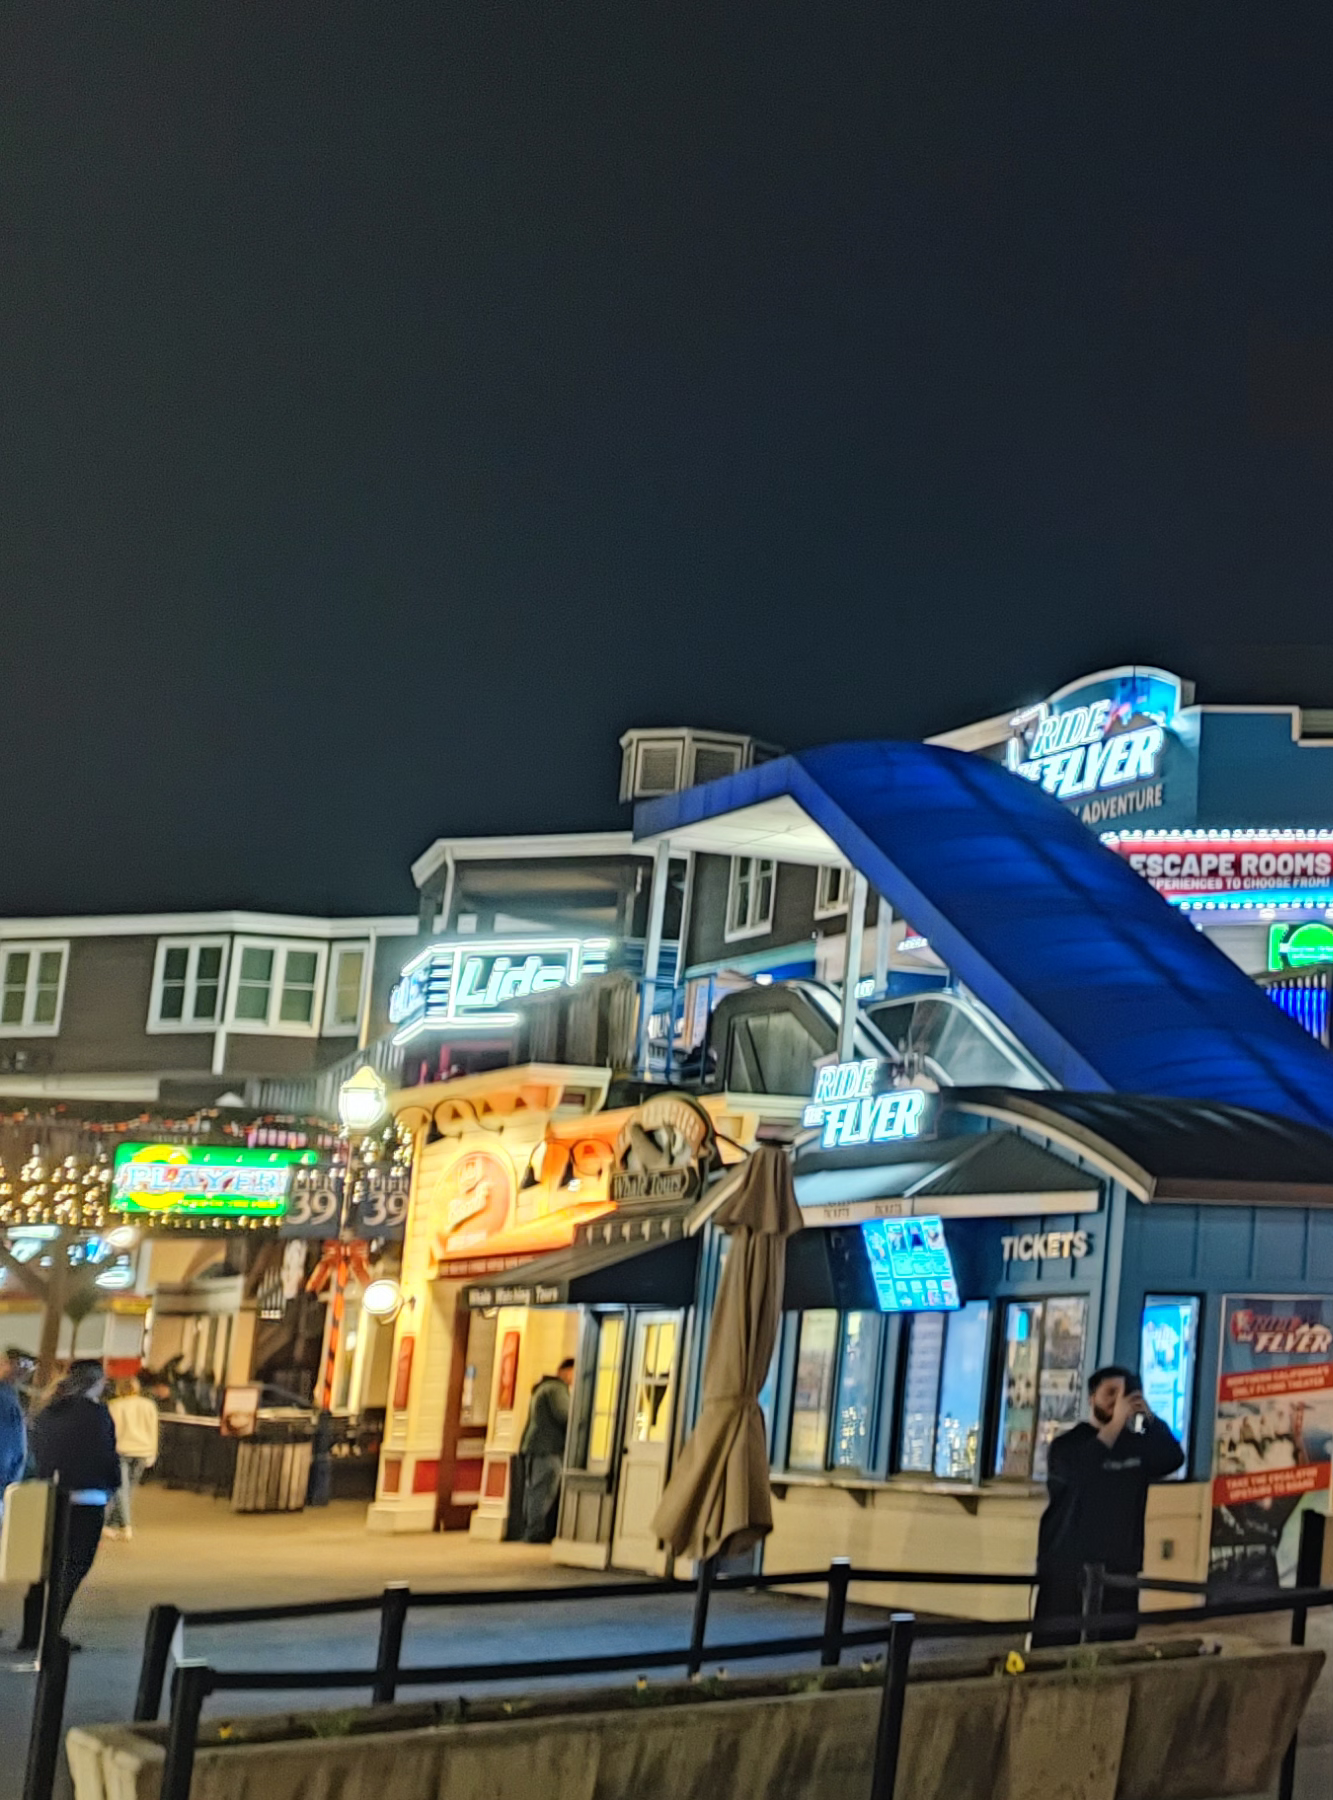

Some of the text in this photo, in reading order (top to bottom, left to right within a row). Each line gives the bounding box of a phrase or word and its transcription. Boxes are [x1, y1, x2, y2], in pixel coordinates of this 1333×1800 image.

[1030, 699, 1111, 759] RIDE
[1041, 726, 1164, 799] FLYER
[1082, 783, 1163, 824] ADVENTURE
[1130, 852, 1333, 877] ESCAPE ROOMS
[1232, 877, 1241, 888] TO
[1243, 877, 1290, 889] CHOOSE
[1292, 876, 1330, 888] FROM!
[814, 1058, 878, 1104] RIDE
[822, 1089, 925, 1148] FLYER
[285, 1190, 338, 1225] 39
[363, 1190, 409, 1227] 39
[1001, 1231, 1088, 1261] TICKETS
[1255, 1329, 1332, 1353] FLYER
